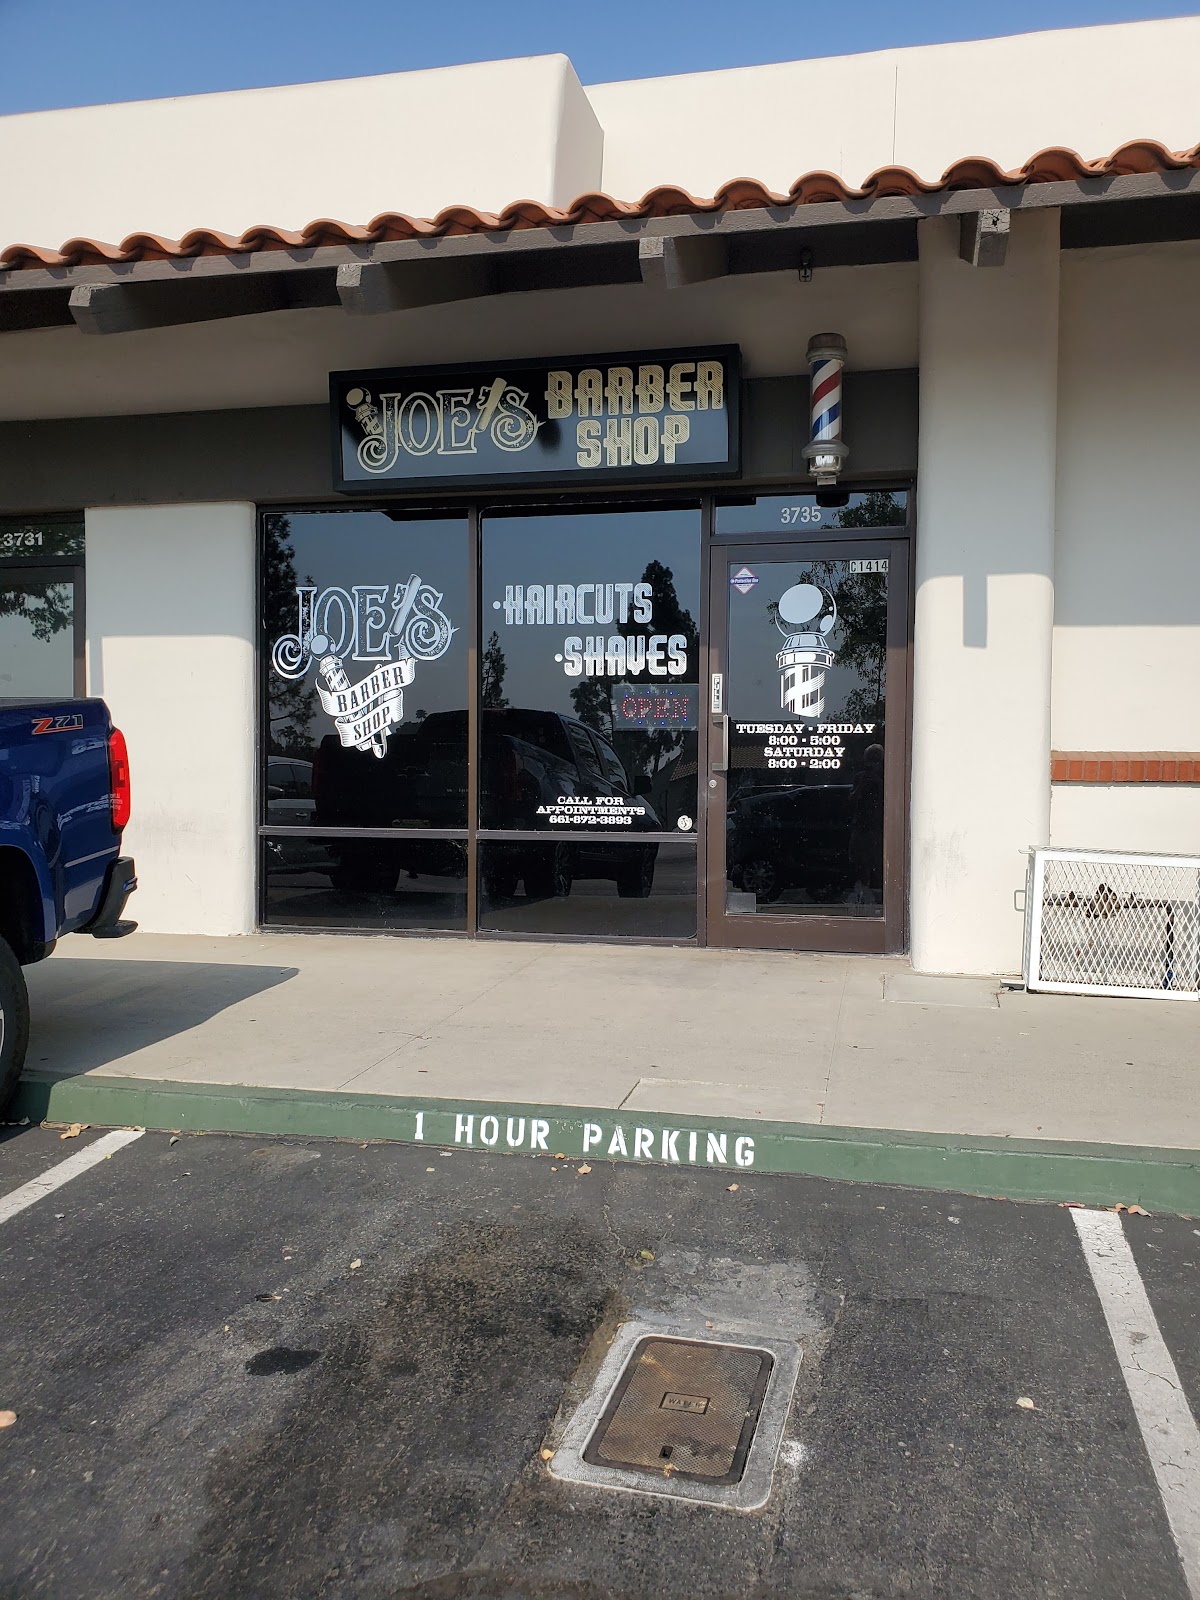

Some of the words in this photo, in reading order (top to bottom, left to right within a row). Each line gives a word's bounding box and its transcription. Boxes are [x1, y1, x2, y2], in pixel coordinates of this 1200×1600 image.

[544, 361, 723, 419] BARBER
[357, 378, 545, 473] JOE'S
[576, 414, 690, 467] SHOP
[781, 506, 821, 524] 3735
[3, 531, 43, 546] 3731
[850, 561, 889, 572] C1414
[272, 573, 452, 679] JOE'S
[336, 666, 405, 712] BARBER
[622, 698, 688, 719] OPEN
[32, 714, 83, 735] Z71
[354, 706, 390, 740] SHOP
[736, 724, 804, 734] TUESDAY
[817, 723, 875, 734] FRIDAY
[769, 735, 798, 746] 8:00
[810, 735, 840, 746] 5:00
[764, 747, 845, 757] SATURDAY
[768, 758, 797, 769] 8:00
[809, 758, 840, 769] 2:00
[557, 796, 592, 805] CALL
[595, 796, 624, 805] FOR
[536, 806, 645, 815] APPOINTMENTS
[414, 1112, 424, 1140] 1
[455, 1113, 550, 1150] HOUR
[582, 1123, 755, 1166] PARKING
